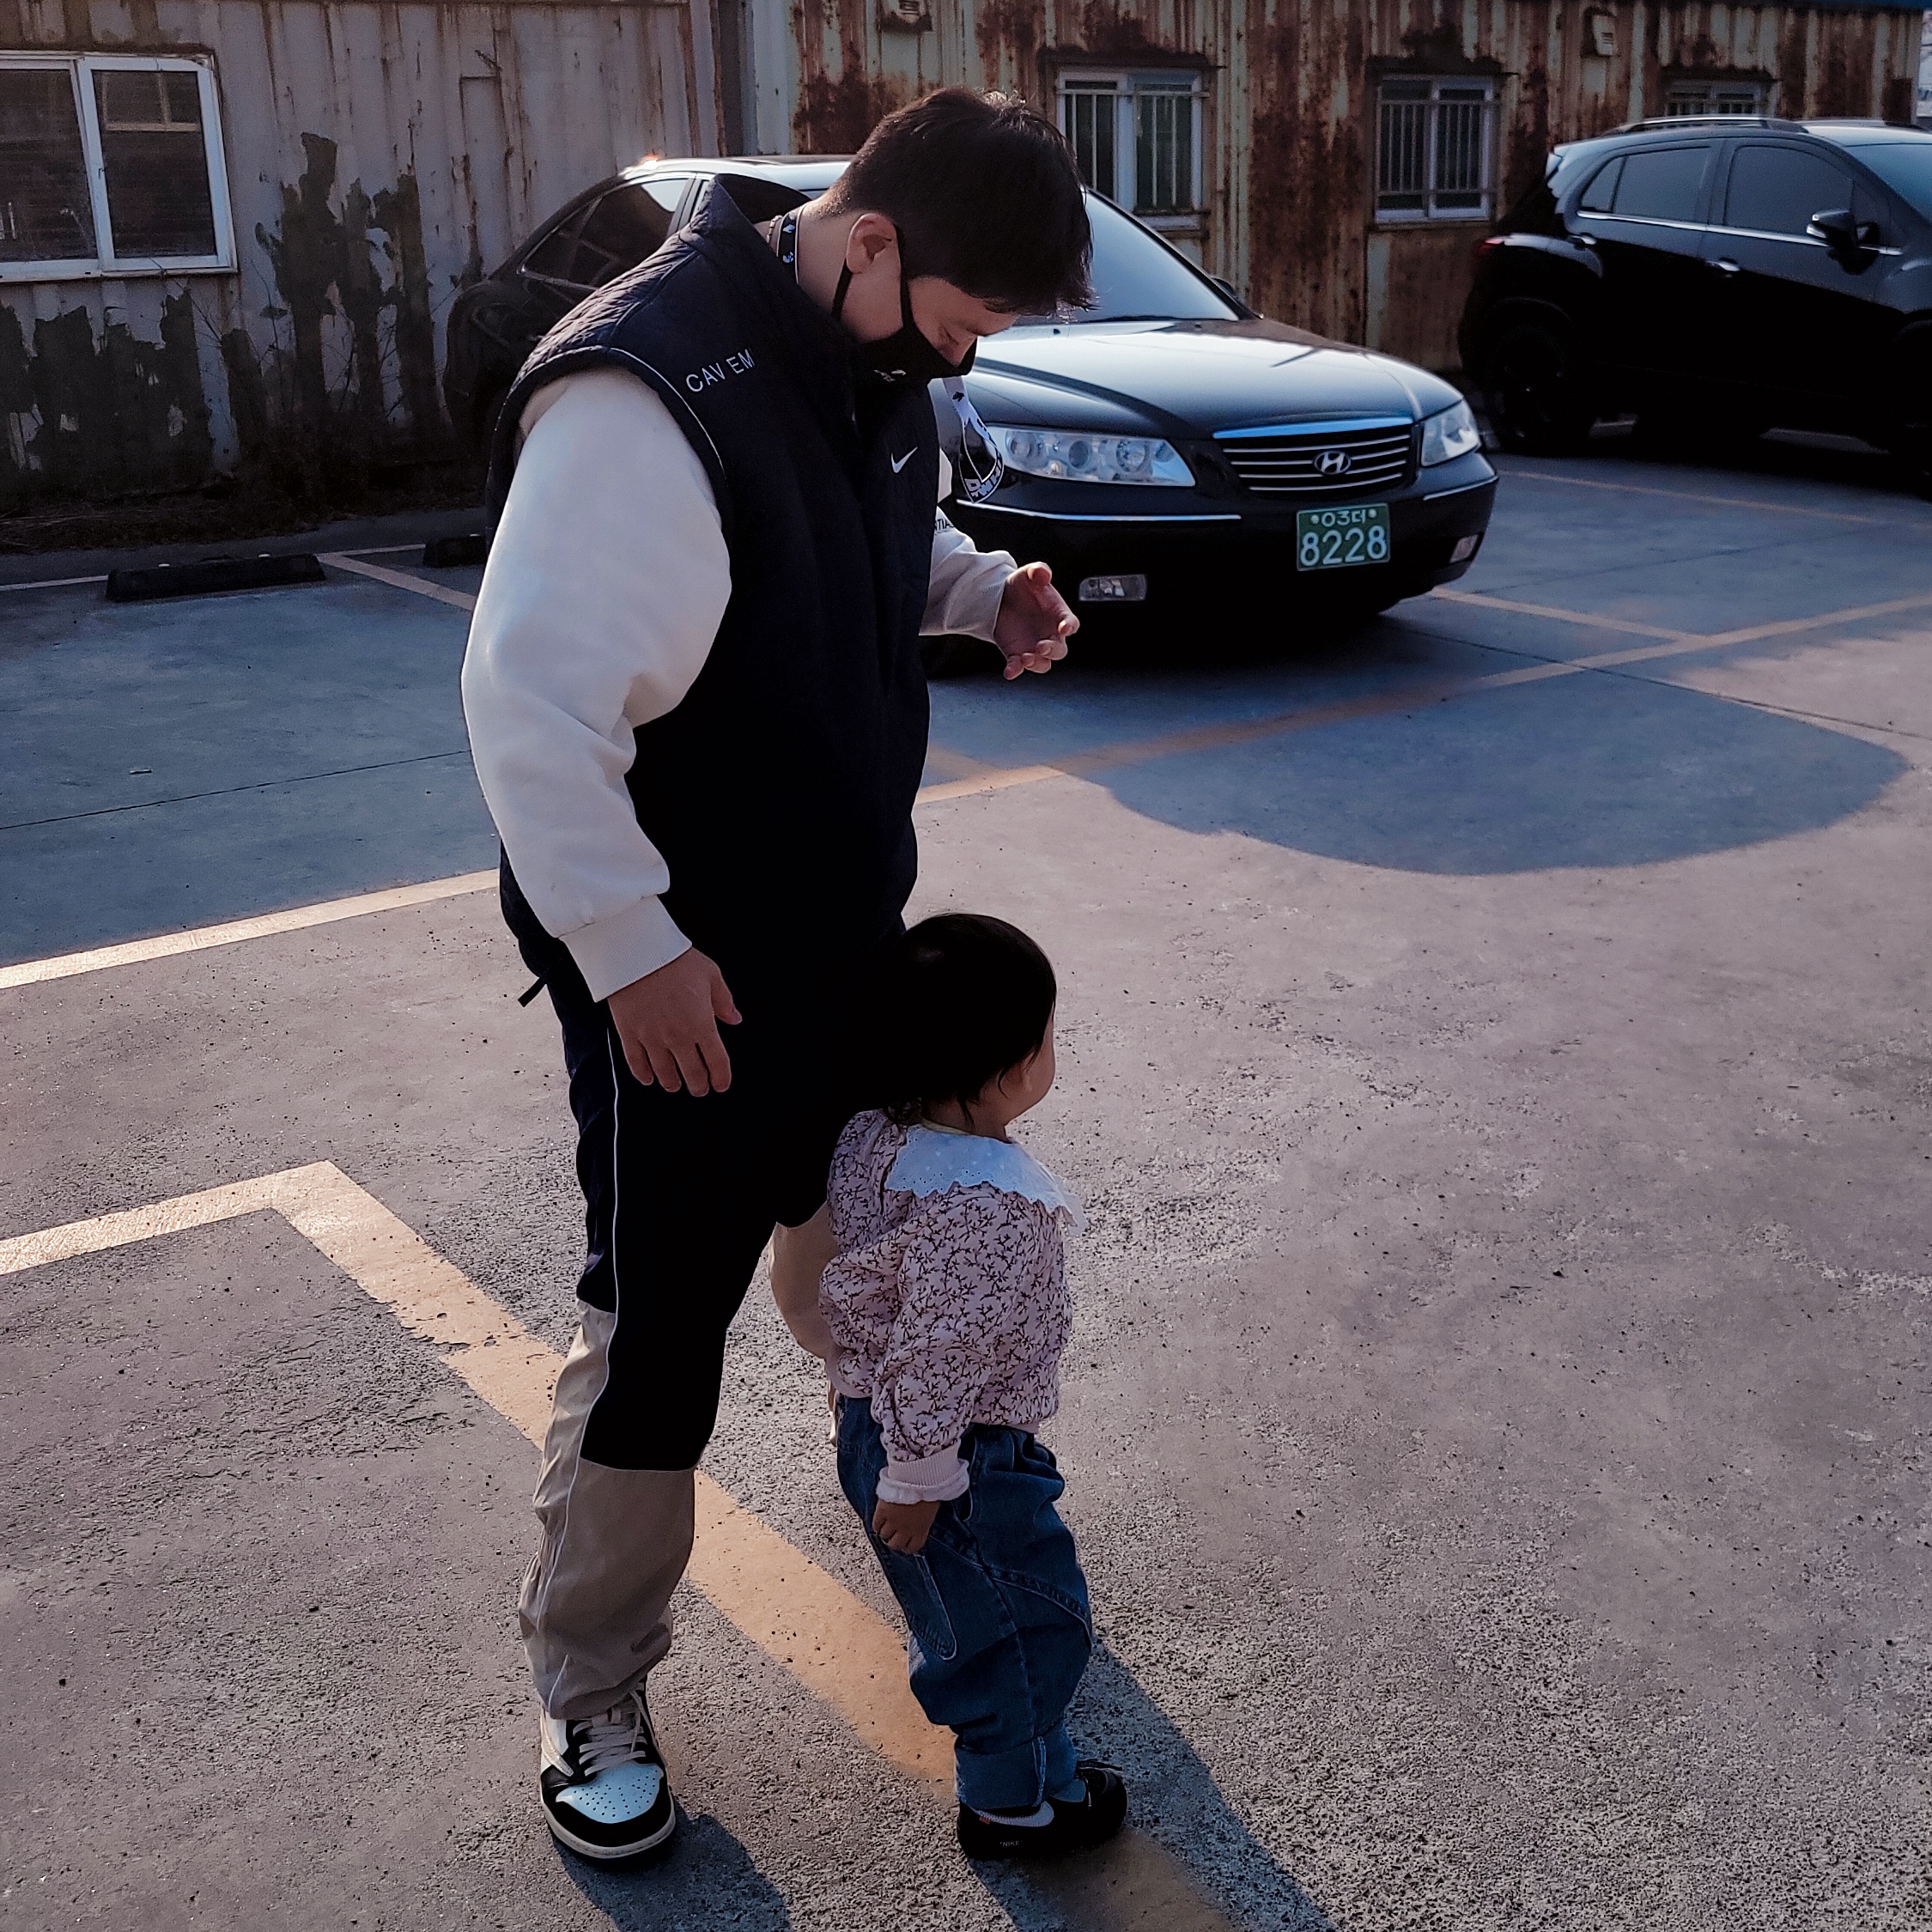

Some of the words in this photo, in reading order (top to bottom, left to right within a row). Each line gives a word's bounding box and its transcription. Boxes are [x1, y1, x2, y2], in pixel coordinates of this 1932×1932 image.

[686, 362, 726, 392] CAV
[1321, 509, 1366, 527] 03더
[1300, 526, 1387, 567] 8228
